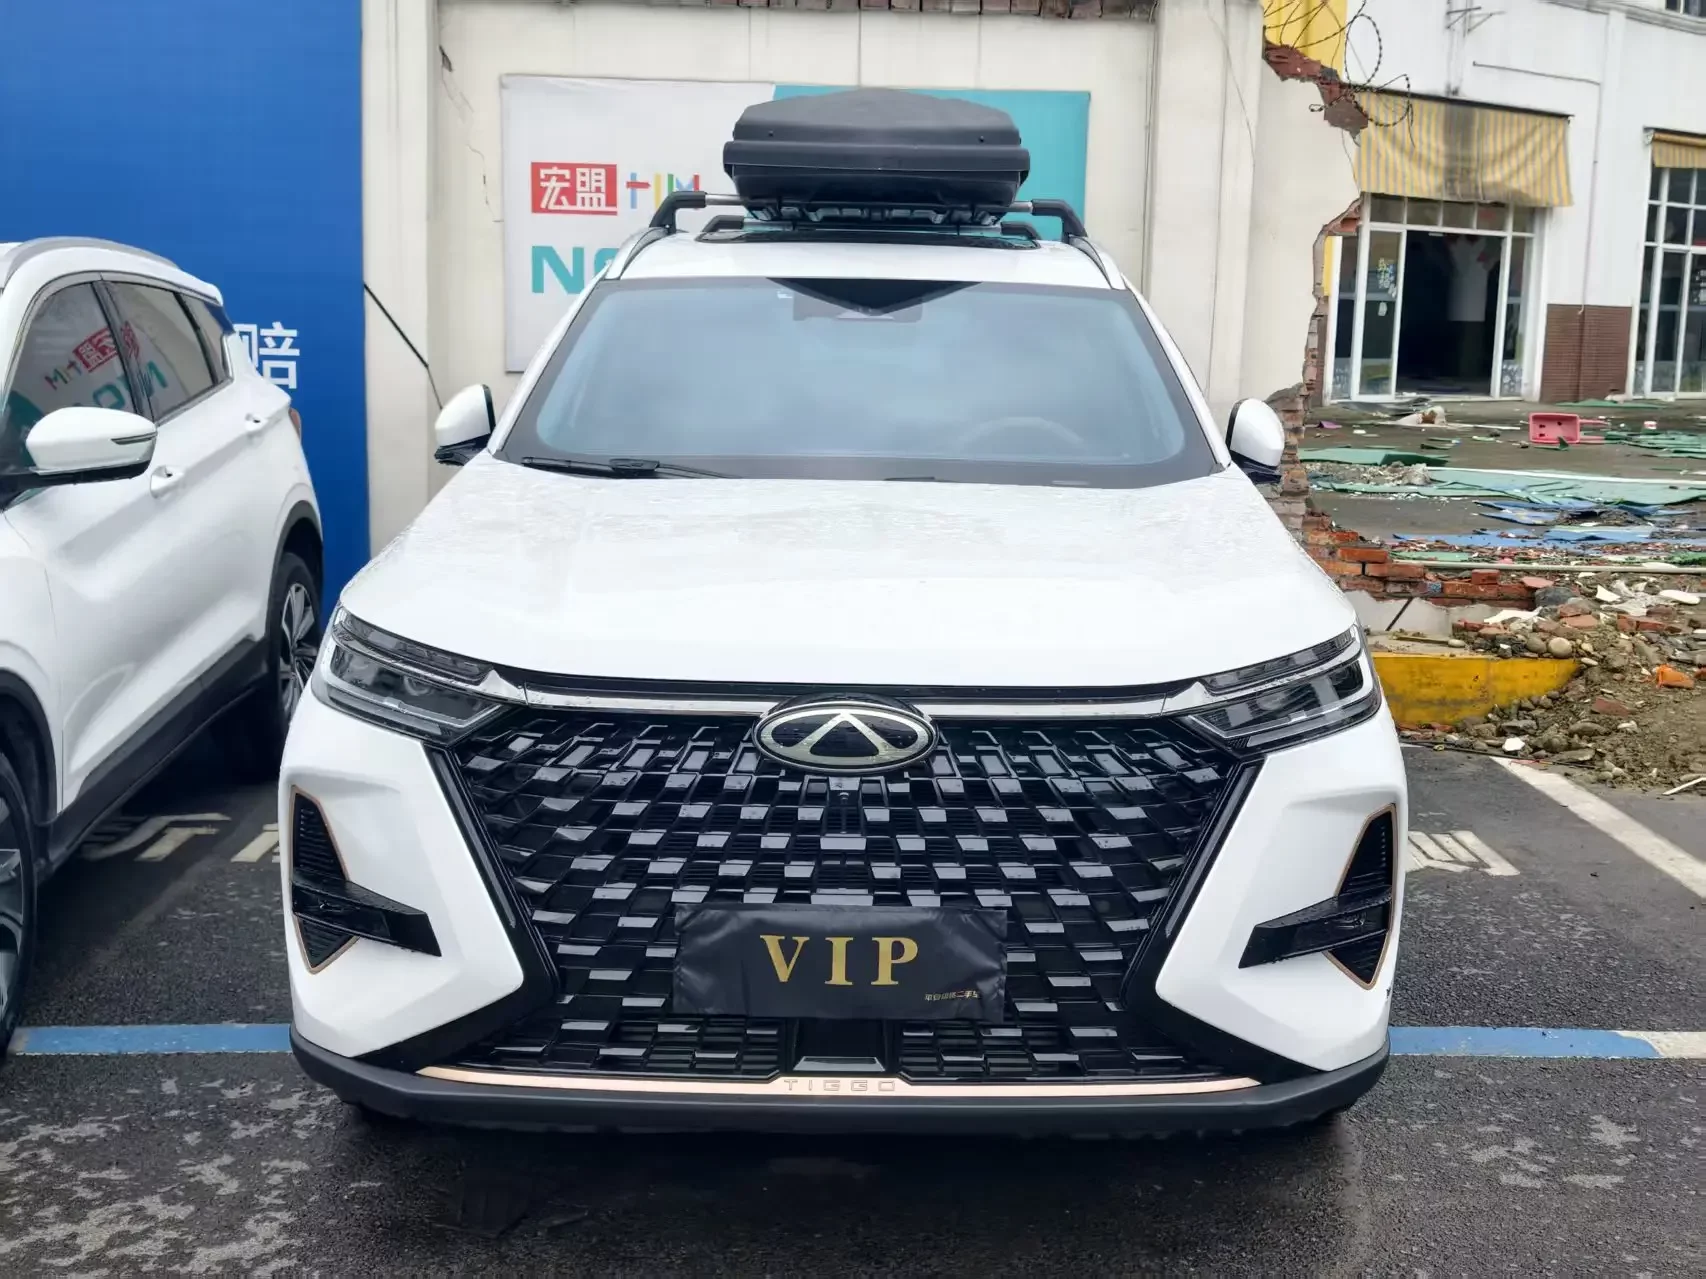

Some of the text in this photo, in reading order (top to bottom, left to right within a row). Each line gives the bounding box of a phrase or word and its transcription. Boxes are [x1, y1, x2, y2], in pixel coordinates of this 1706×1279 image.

[539, 165, 608, 211] 宏盟
[759, 934, 919, 986] VIP
[783, 1079, 895, 1092] TIGGO
